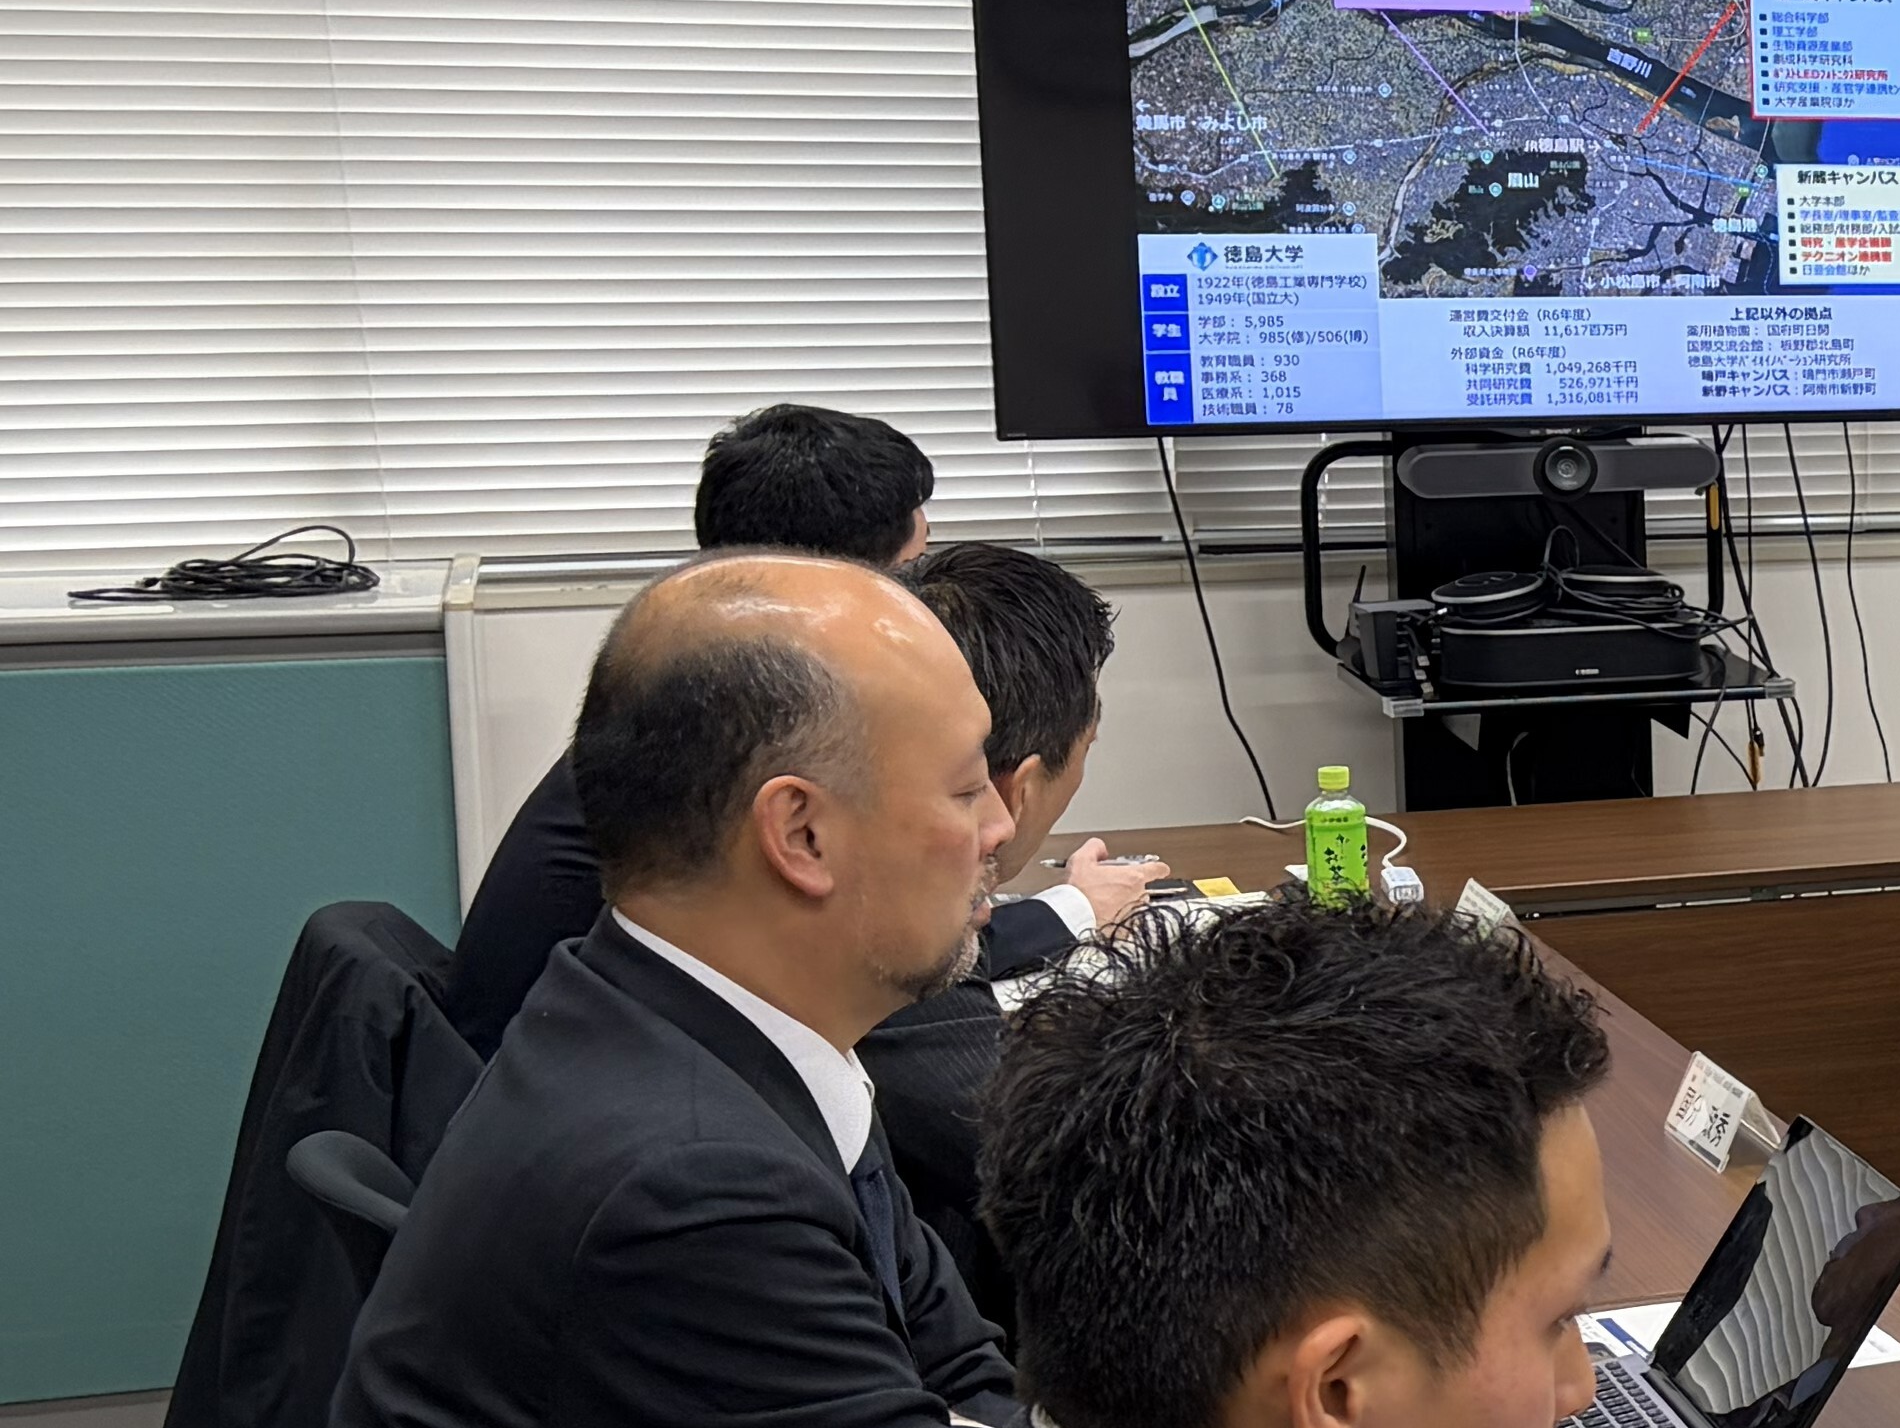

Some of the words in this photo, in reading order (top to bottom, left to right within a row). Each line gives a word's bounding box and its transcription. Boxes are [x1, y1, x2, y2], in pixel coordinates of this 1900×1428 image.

[1798, 171, 1899, 185] 新蔵キャンパス
[1224, 245, 1303, 262] 徳島大学
[1731, 307, 1832, 320] 上記以外の拠点
[1274, 355, 1299, 366] 930
[1261, 371, 1287, 382] 368
[1262, 387, 1300, 399] 1,015
[1277, 403, 1293, 414] 78
